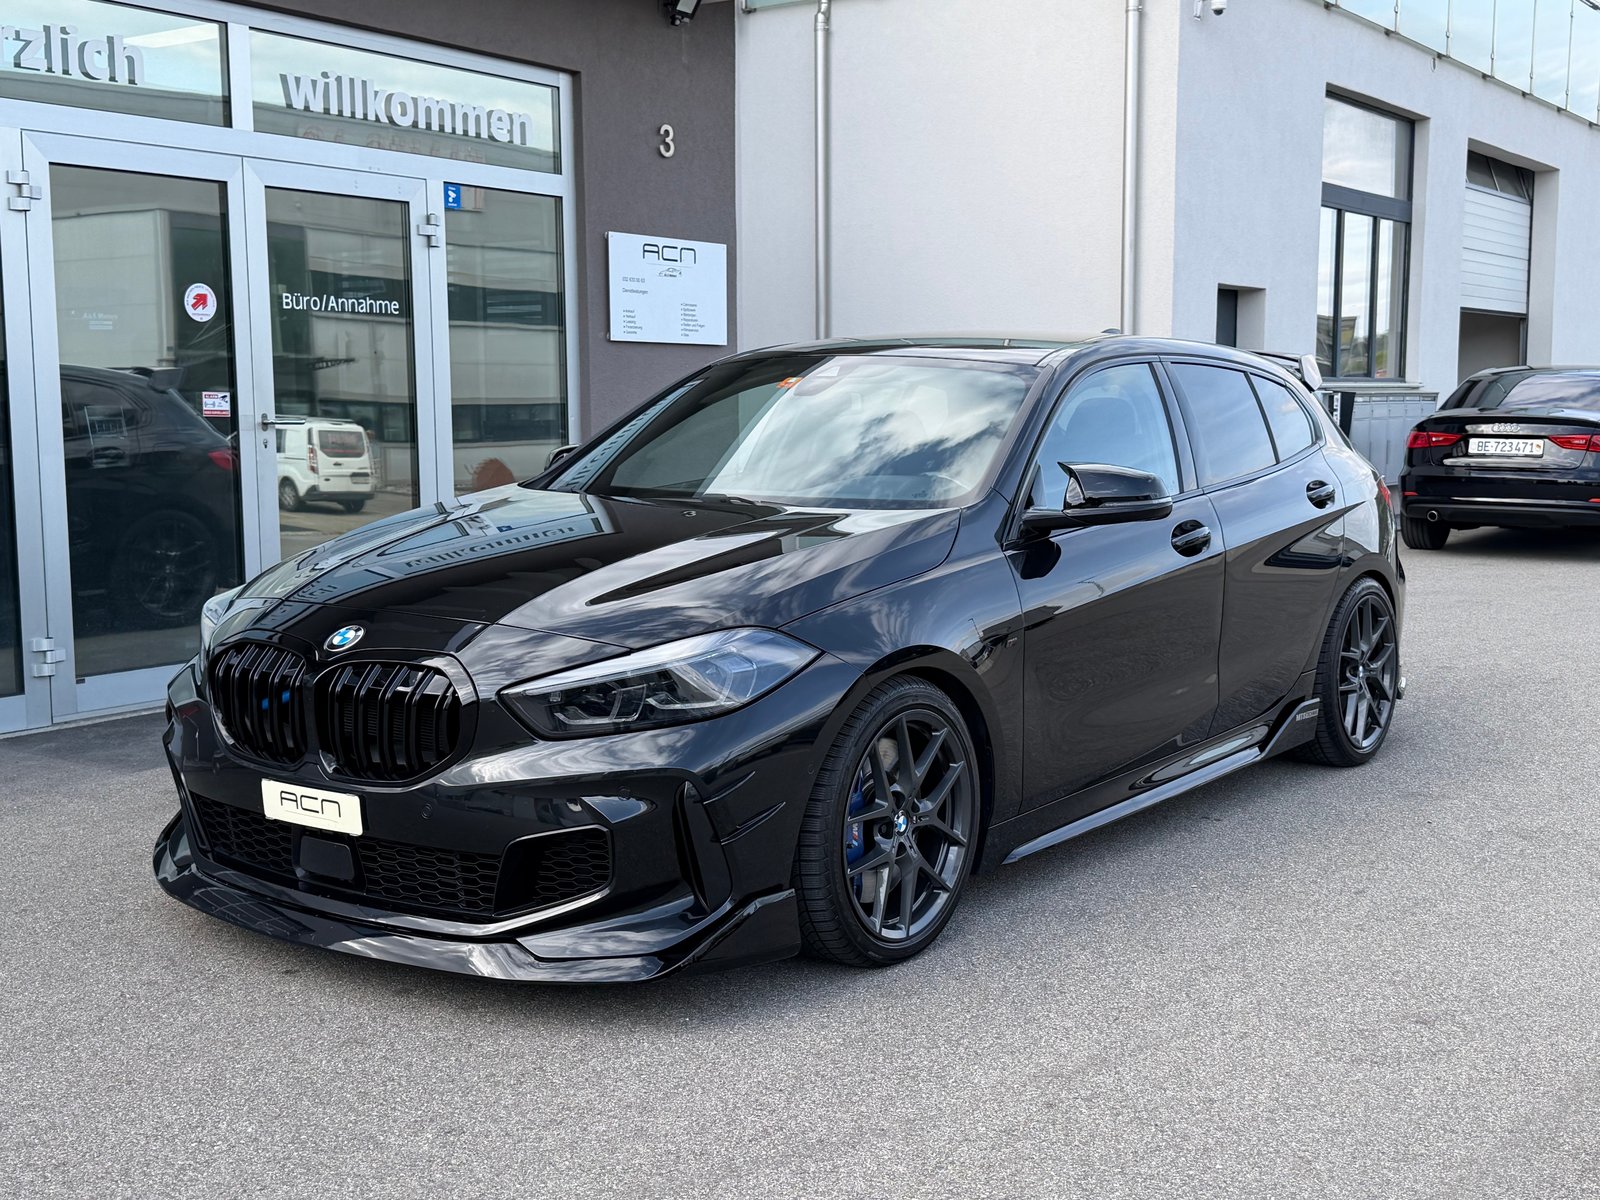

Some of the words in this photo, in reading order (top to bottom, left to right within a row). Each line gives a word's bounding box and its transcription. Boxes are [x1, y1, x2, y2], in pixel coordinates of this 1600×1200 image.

[282, 71, 533, 146] willkommen
[660, 124, 675, 157] 3
[282, 293, 400, 314] Büro/Annahme
